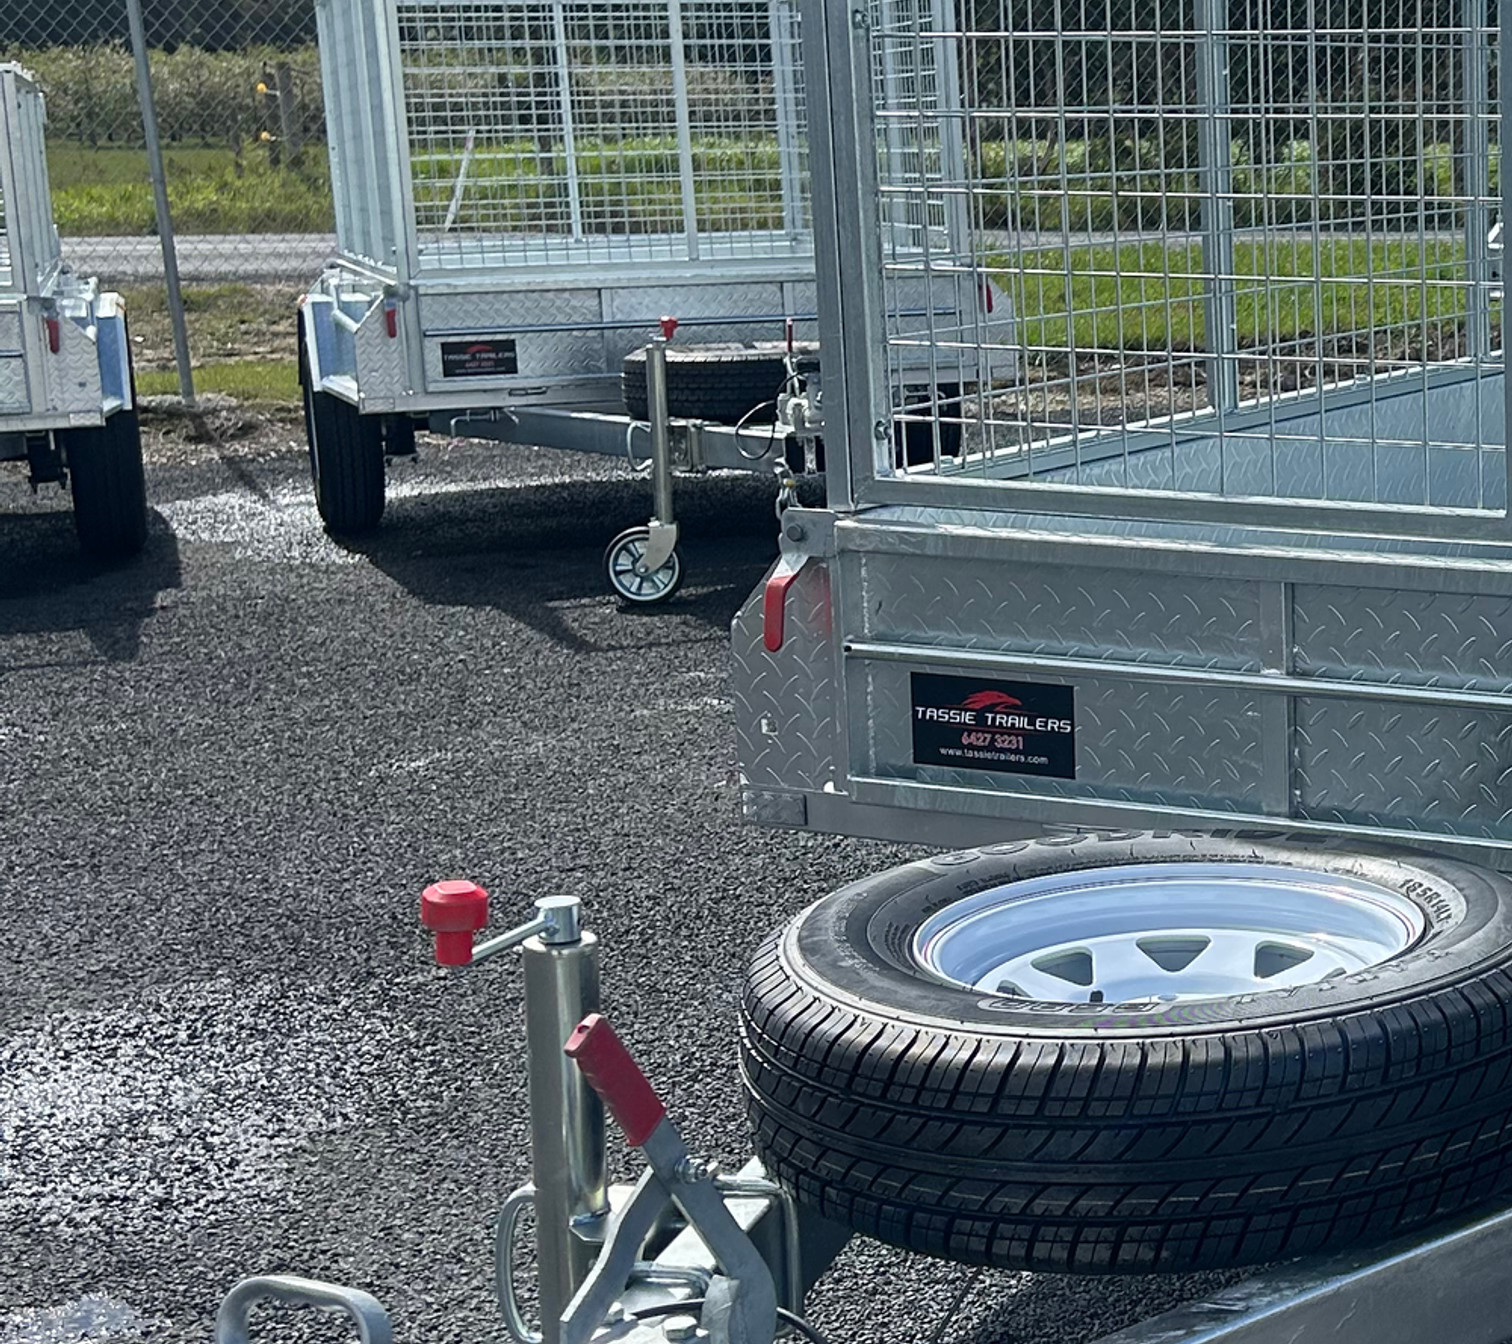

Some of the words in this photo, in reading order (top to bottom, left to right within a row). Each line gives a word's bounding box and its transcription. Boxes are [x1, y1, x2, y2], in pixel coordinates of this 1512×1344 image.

[914, 706, 977, 725] TASSIE
[984, 712, 1072, 733] TRAILERS
[961, 731, 991, 747] 6427
[994, 734, 1024, 750] 3231
